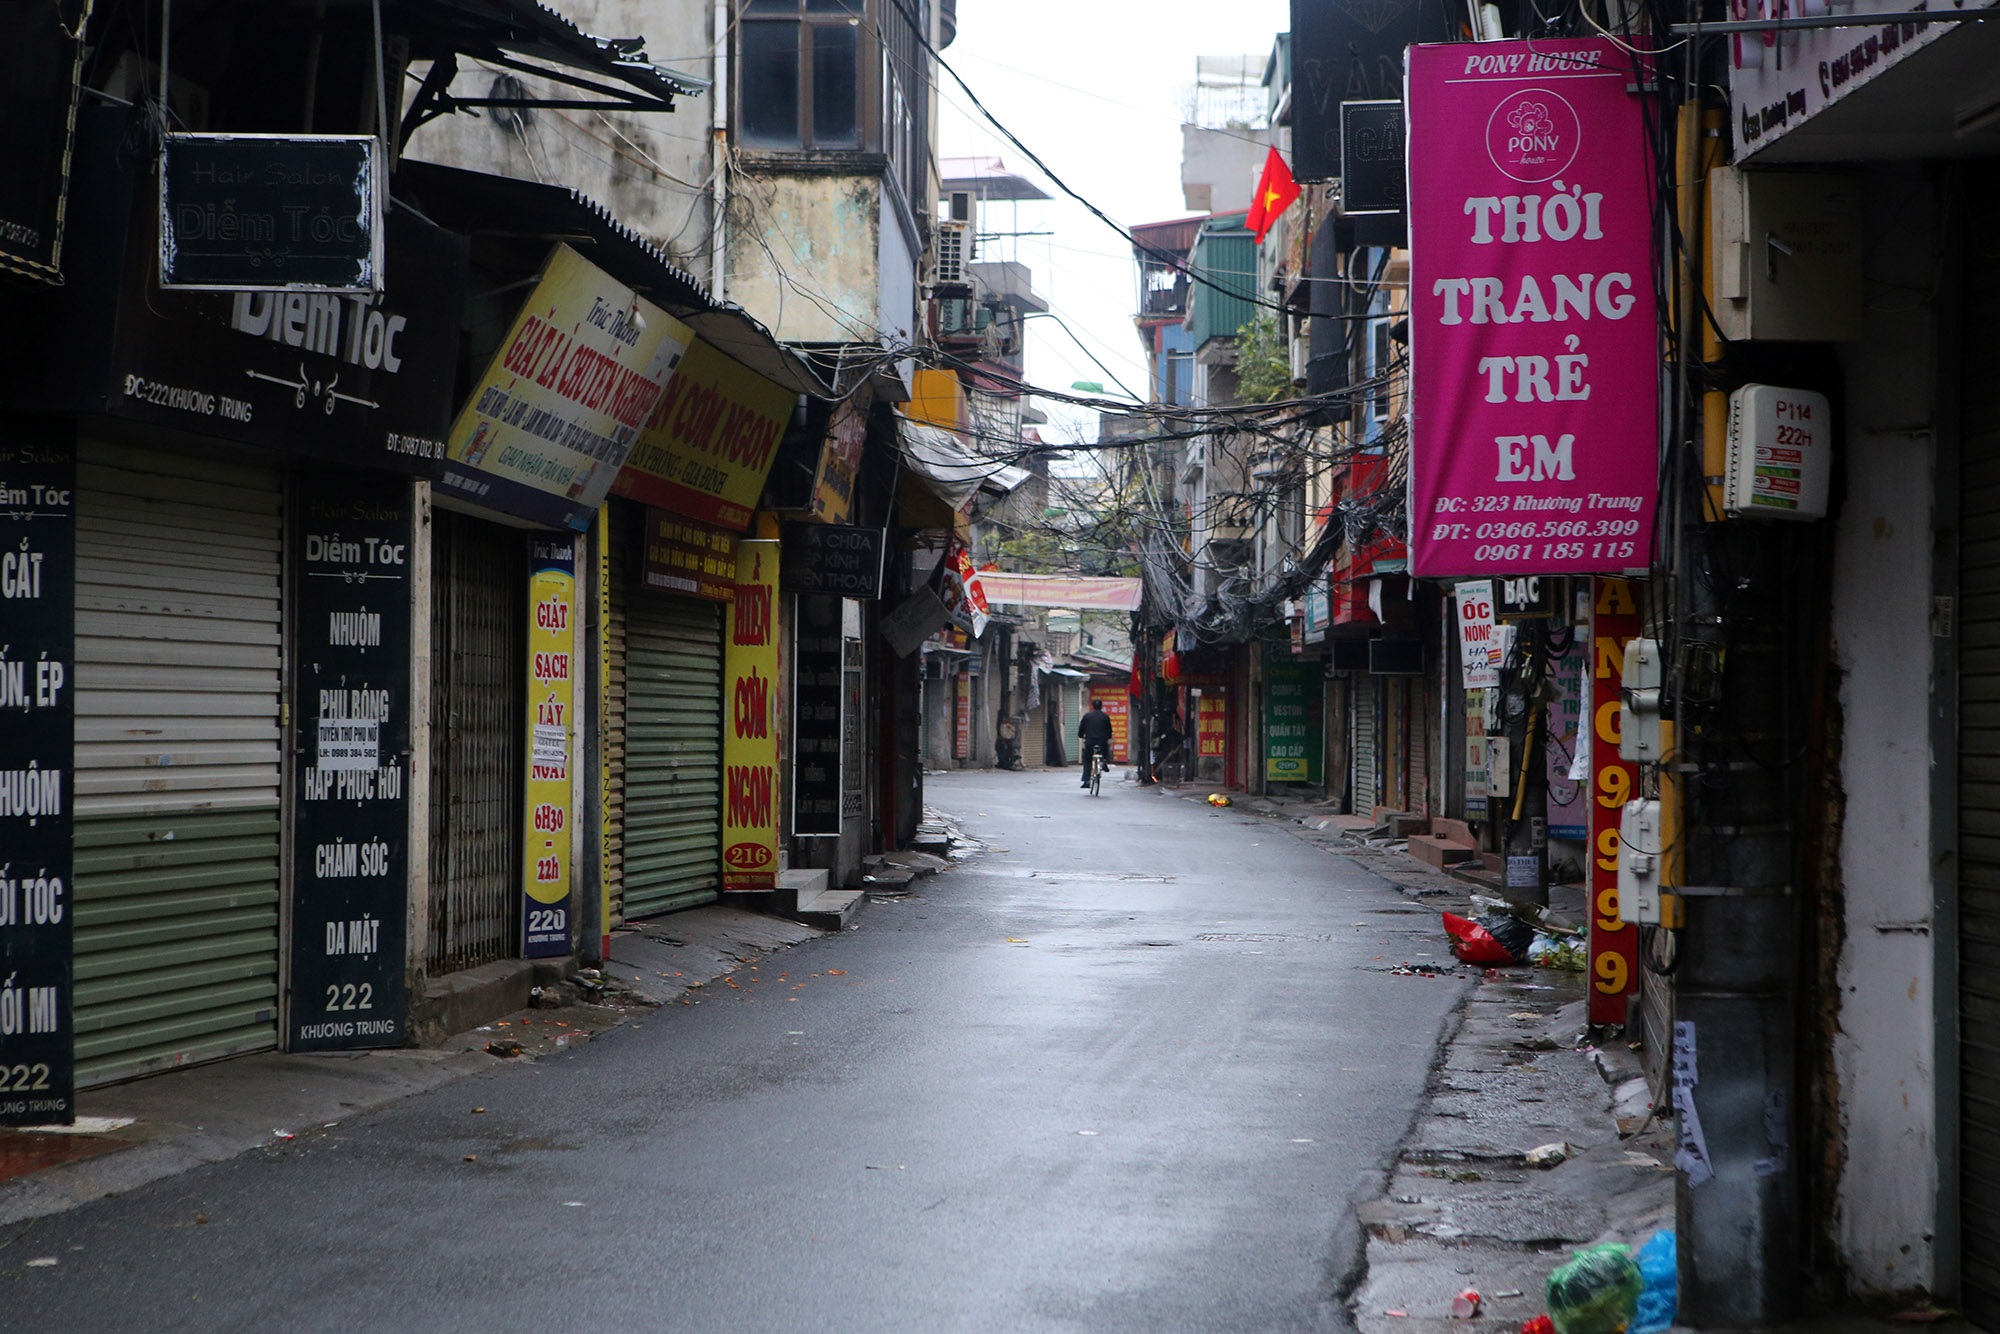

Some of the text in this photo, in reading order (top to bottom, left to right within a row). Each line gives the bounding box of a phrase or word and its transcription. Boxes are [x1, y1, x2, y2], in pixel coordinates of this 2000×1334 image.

[1464, 51, 1602, 75] PONY HOUSE
[1508, 135, 1559, 152] PONY
[192, 161, 343, 186] Hair Salon
[1520, 154, 1545, 166] house
[177, 199, 358, 243] Diễm Tóc
[1464, 180, 1604, 244] THỜI
[586, 296, 612, 329] Trúc
[1433, 272, 1636, 325] TRANG
[344, 292, 407, 373] Tóc
[1478, 334, 1591, 403] TRẺ
[219, 397, 252, 422] TRUNG
[1776, 400, 1811, 421] P114
[711, 402, 781, 475] NGON
[1776, 425, 1812, 447] 222H
[1494, 433, 1576, 482] EM
[30, 484, 71, 506] Tóc
[1435, 493, 1643, 513] ĐC: 323 Khương Trung
[352, 501, 398, 522] Salon
[1432, 520, 1639, 541] ĐT: 0366.566.399
[305, 532, 405, 565] Diễm Tóc
[1474, 541, 1635, 561] 0961 185 115
[2, 537, 44, 599] CẮT
[1463, 597, 1490, 620] ỐC
[1504, 576, 1540, 611] BẠC
[330, 605, 381, 654] NHUỘM
[537, 597, 568, 635] GIẶT
[37, 651, 64, 707] ÉP
[535, 653, 568, 685] SẠCH
[320, 675, 390, 723] PHỦ BÓNG
[538, 693, 564, 726] LẤY
[734, 665, 768, 740] CƠM
[727, 764, 773, 829] NGON
[534, 805, 564, 832] 6H30
[315, 835, 389, 879] CHĂM SÓC
[537, 856, 559, 881] 22h
[731, 847, 767, 864] 216
[22, 868, 63, 925] TÓC
[528, 909, 566, 932] 220
[326, 913, 380, 961] DA MẶT
[29, 986, 57, 1034] MI
[325, 982, 372, 1011] 222
[301, 1019, 395, 1040] KHƯƠNG TRUNG
[0, 1063, 50, 1092] 222
[28, 1098, 67, 1113] TRUNG
